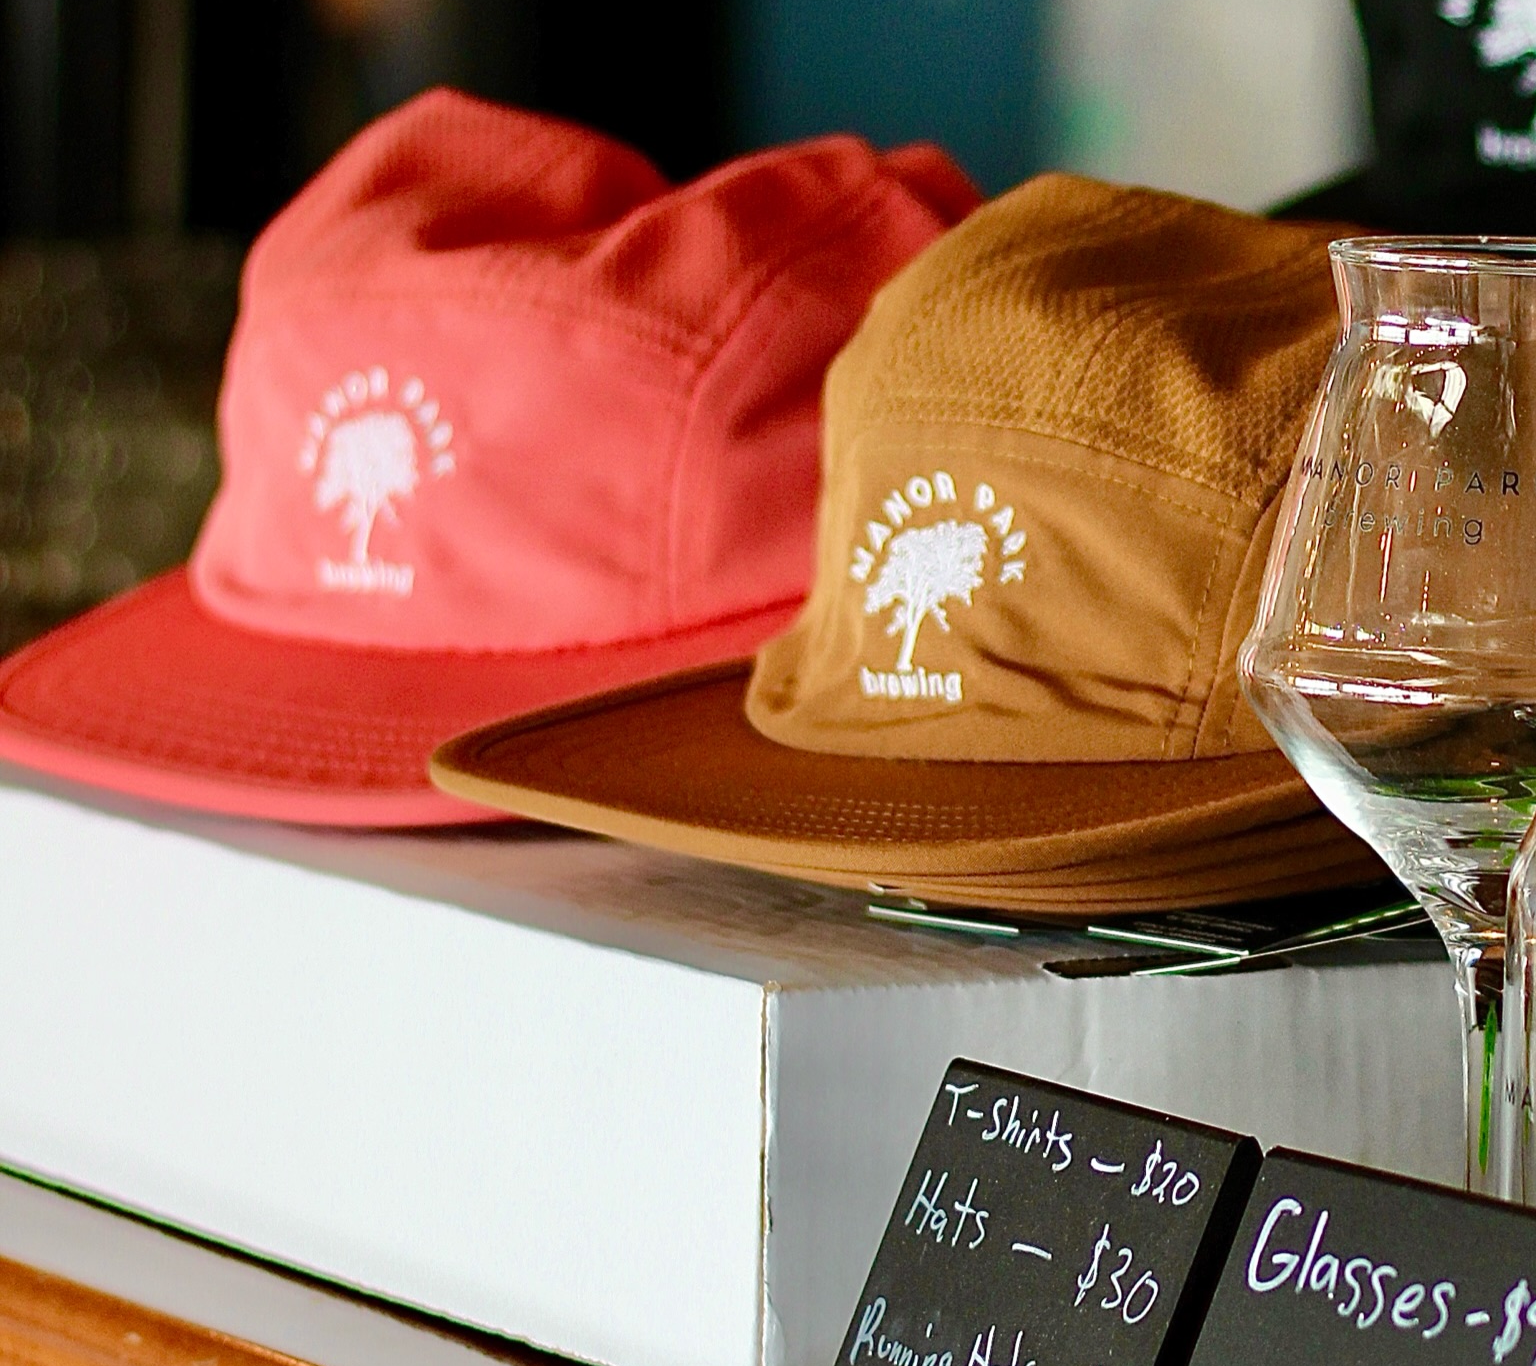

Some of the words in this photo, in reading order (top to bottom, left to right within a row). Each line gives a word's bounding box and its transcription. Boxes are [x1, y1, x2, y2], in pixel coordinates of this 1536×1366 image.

[850, 470, 957, 582] MANOR
[975, 482, 1027, 585] PARK
[860, 666, 963, 701] brewing
[1131, 1139, 1199, 1206] $20
[905, 1170, 989, 1249] Hats
[1074, 1224, 1158, 1324] $30
[1248, 1198, 1456, 1339] Glasses
